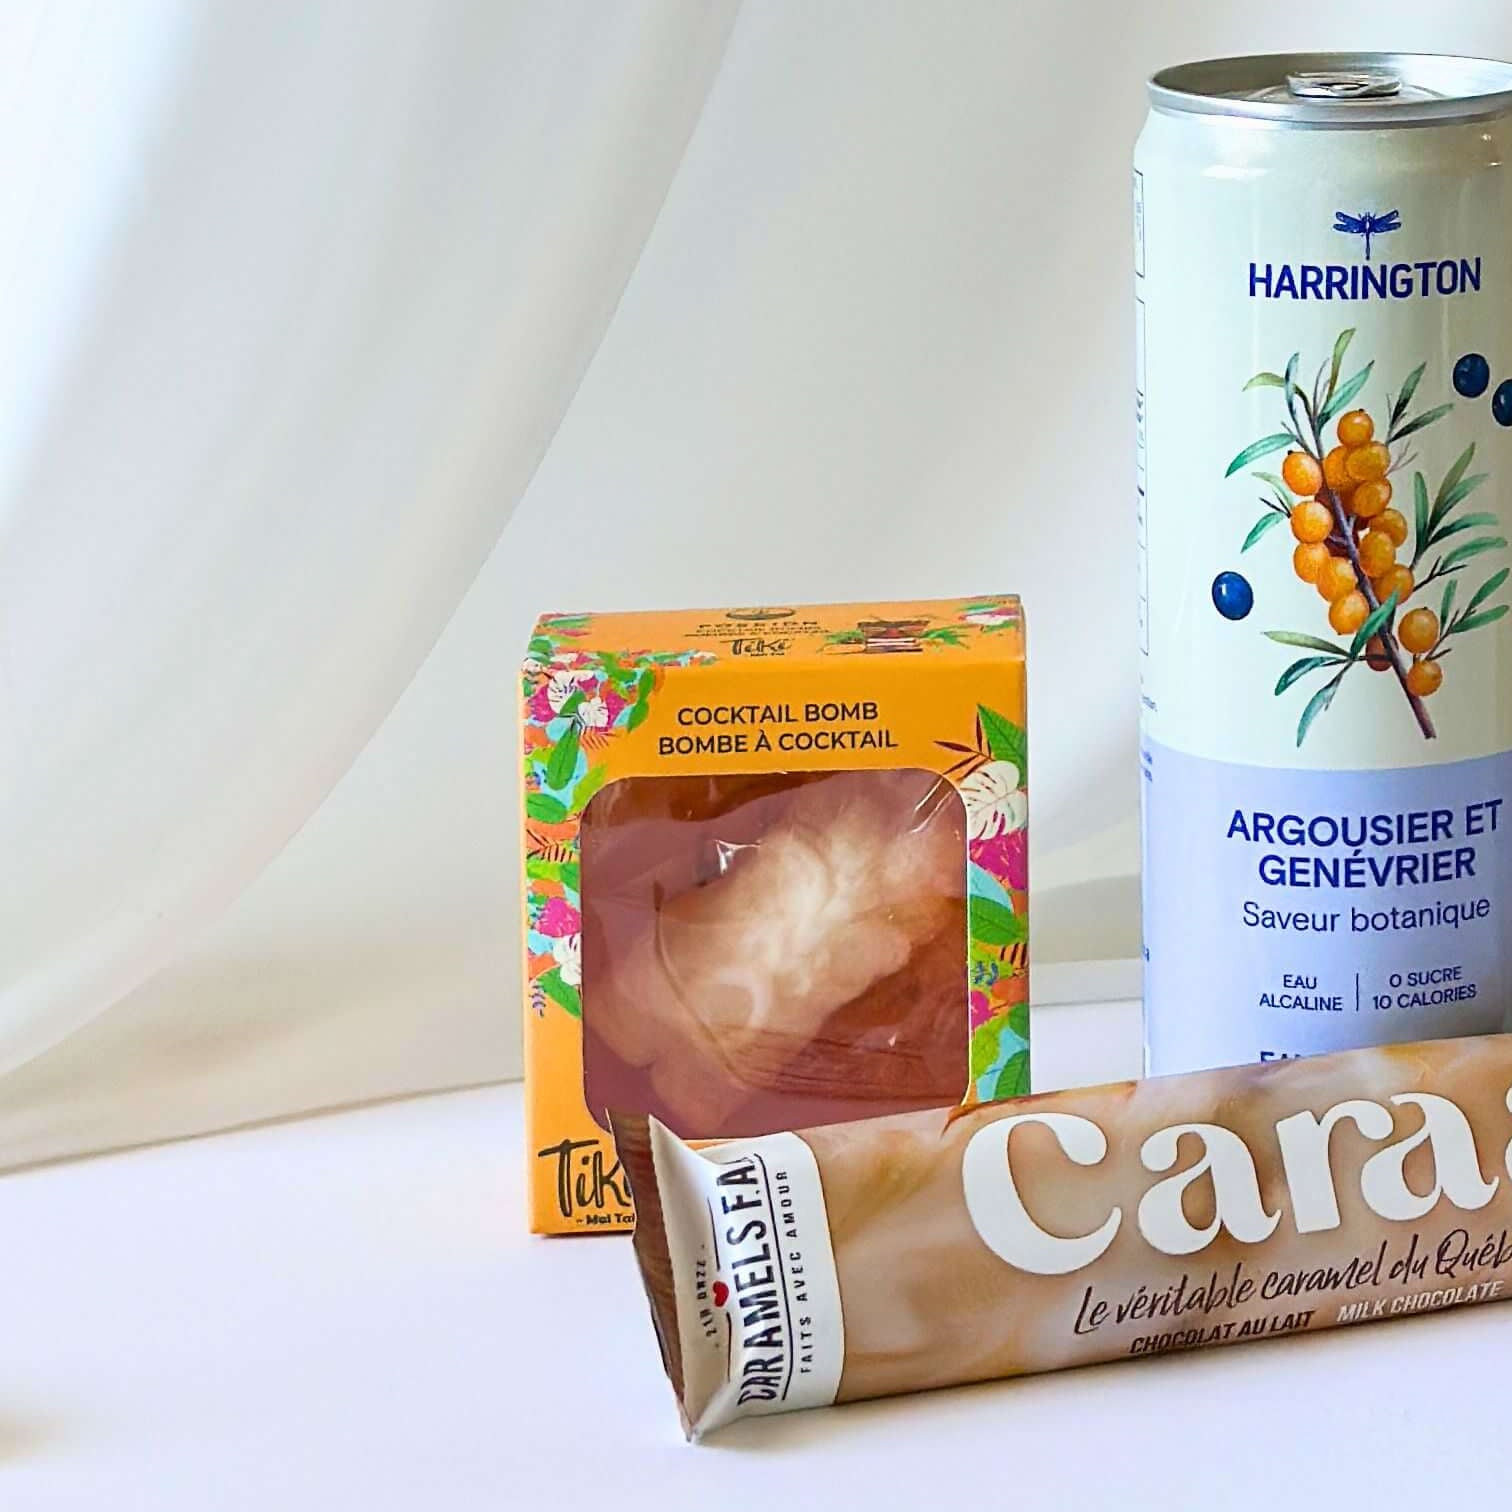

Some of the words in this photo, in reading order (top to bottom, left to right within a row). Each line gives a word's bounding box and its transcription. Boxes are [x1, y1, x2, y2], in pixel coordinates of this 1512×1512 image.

[1249, 256, 1481, 300] HARRINGTON
[677, 704, 798, 726] COCKTAIL
[804, 702, 878, 723] BOMB
[658, 734, 748, 756] BOMBE
[754, 729, 772, 752] À
[778, 729, 899, 751] COCKTAIL
[1227, 808, 1454, 848] ARGOUSIER
[1465, 798, 1503, 837] ET
[1258, 846, 1476, 889] GENÉVRIER
[1242, 900, 1341, 932] Saveur
[1350, 896, 1491, 933] botanique
[1283, 974, 1317, 990] EAU
[1373, 994, 1393, 1010] 10
[1397, 984, 1477, 1009] CALORIES
[1407, 966, 1462, 988] SUCRE
[1259, 993, 1343, 1012] ALCALINE
[776, 1170, 799, 1239] AMOUR
[789, 1251, 808, 1303] AVEC
[1073, 1285, 1112, 1336] Le
[1115, 1261, 1257, 1325] véritable
[1261, 1239, 1388, 1301] caramel
[1388, 1233, 1430, 1285] du
[726, 1219, 785, 1407] CARAMELS
[1336, 1298, 1387, 1323] MILK
[1390, 1280, 1506, 1315] CHOCOLATE
[801, 1315, 813, 1374] FAITS
[1129, 1322, 1237, 1354] CHOCOLAT
[1237, 1316, 1267, 1338] AU
[1269, 1310, 1317, 1332] LAIT
